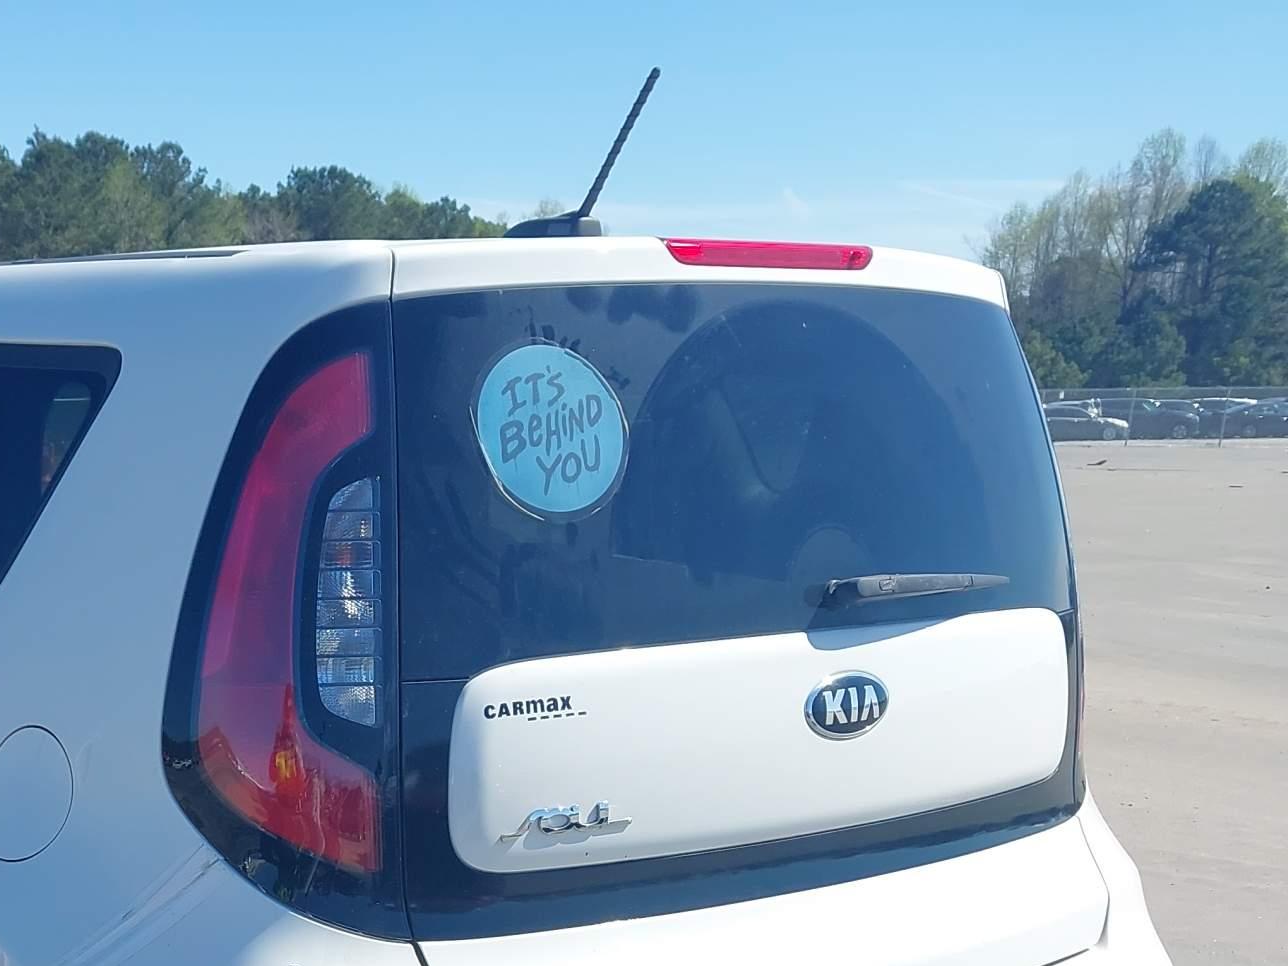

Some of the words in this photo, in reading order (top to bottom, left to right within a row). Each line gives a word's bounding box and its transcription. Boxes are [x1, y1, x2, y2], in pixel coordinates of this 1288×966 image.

[500, 365, 566, 417] IT'S
[535, 434, 601, 496] YOU
[822, 684, 880, 726] KIA
